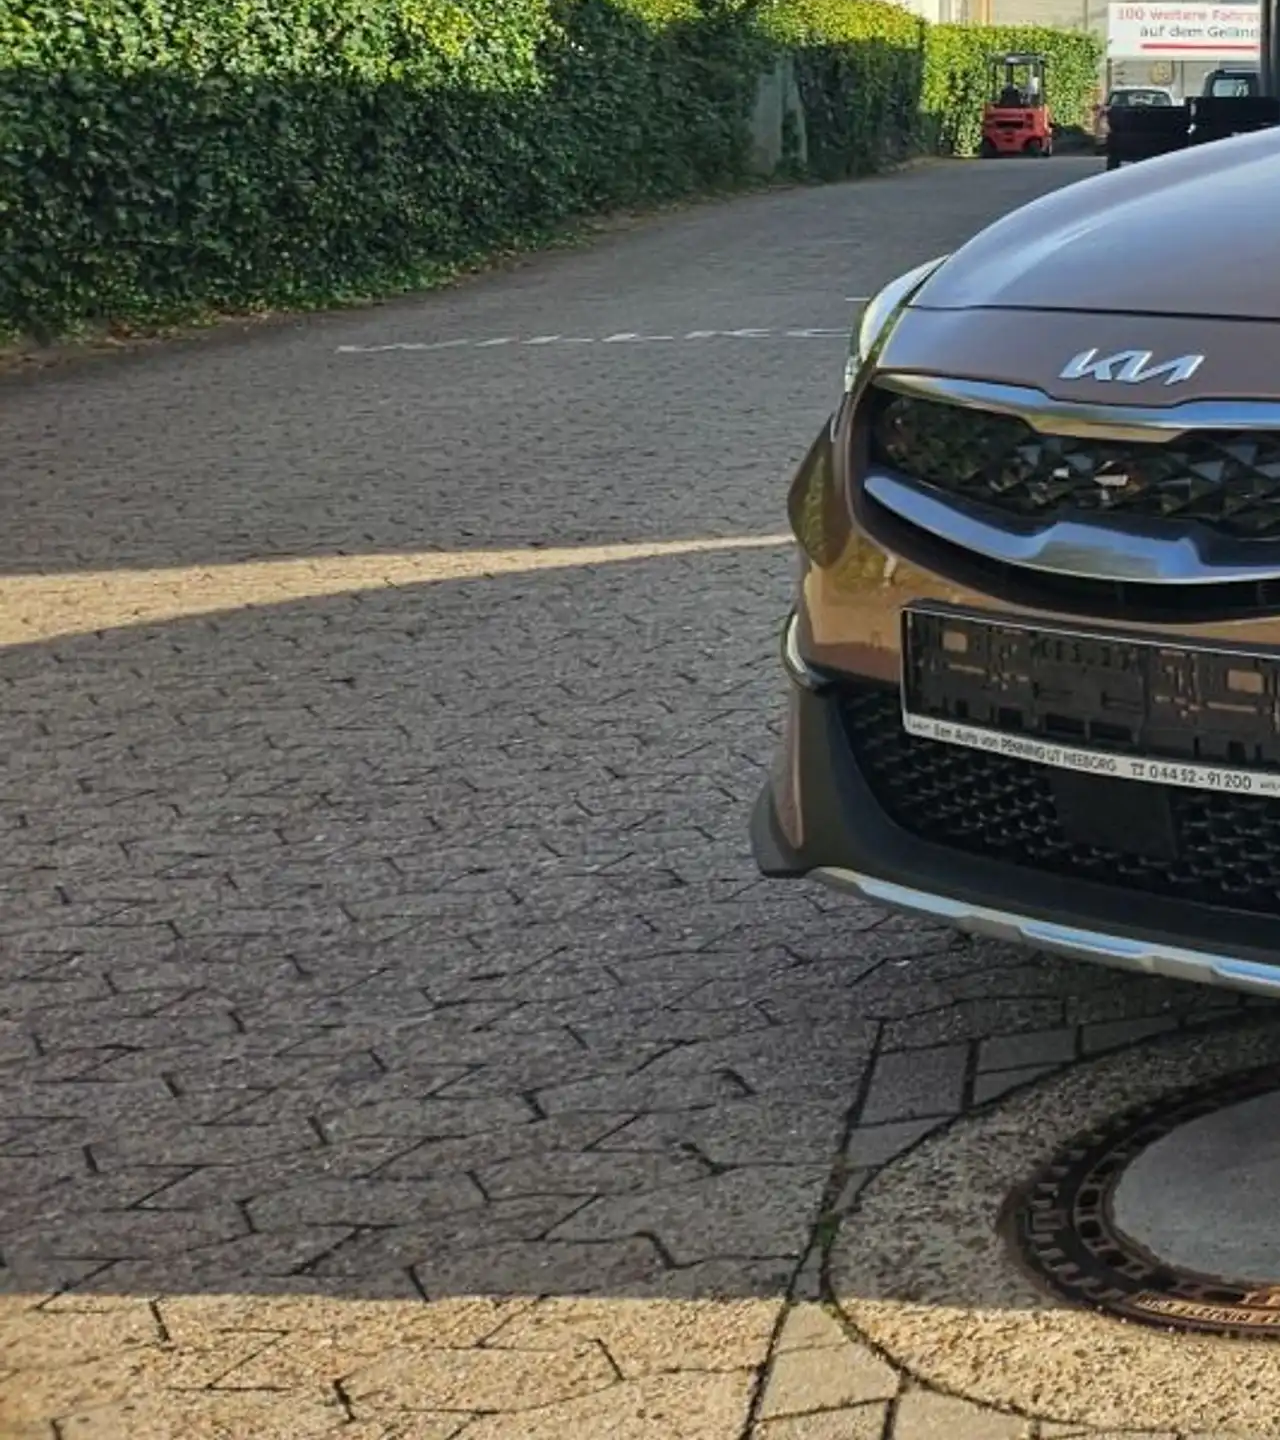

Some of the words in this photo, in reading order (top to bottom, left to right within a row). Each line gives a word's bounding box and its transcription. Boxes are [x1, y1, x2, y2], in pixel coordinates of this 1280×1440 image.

[1116, 9, 1145, 21] 100
[1140, 24, 1165, 38] auf
[1169, 24, 1203, 38] dem
